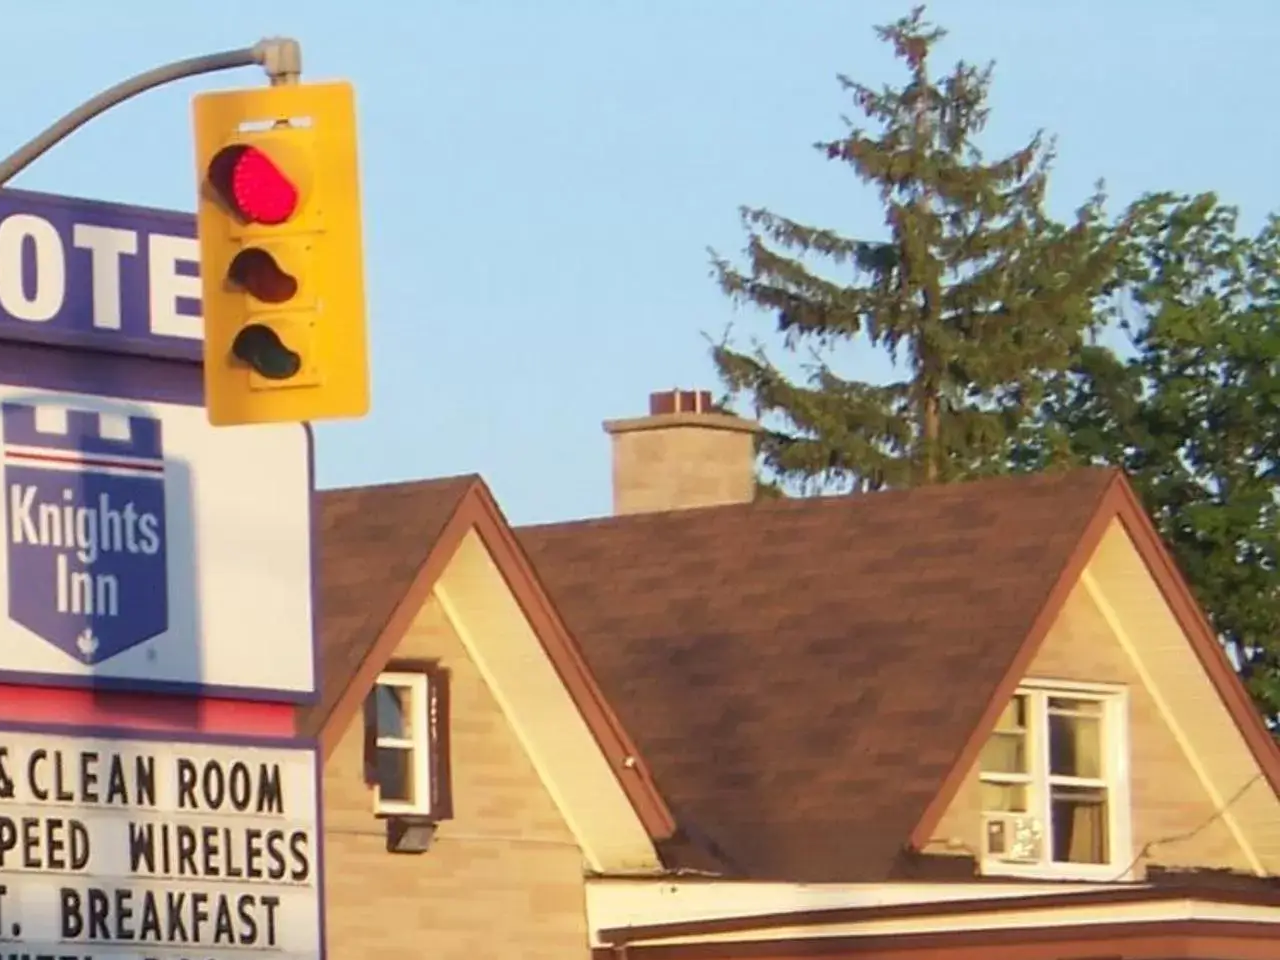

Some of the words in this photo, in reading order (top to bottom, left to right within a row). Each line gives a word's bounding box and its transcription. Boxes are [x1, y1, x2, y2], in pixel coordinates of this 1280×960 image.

[11, 484, 159, 564] Knights
[57, 554, 118, 616] Inn
[177, 757, 283, 813] ROOM
[129, 821, 310, 881] WIRELESS
[60, 887, 279, 946] BREAKFAST
